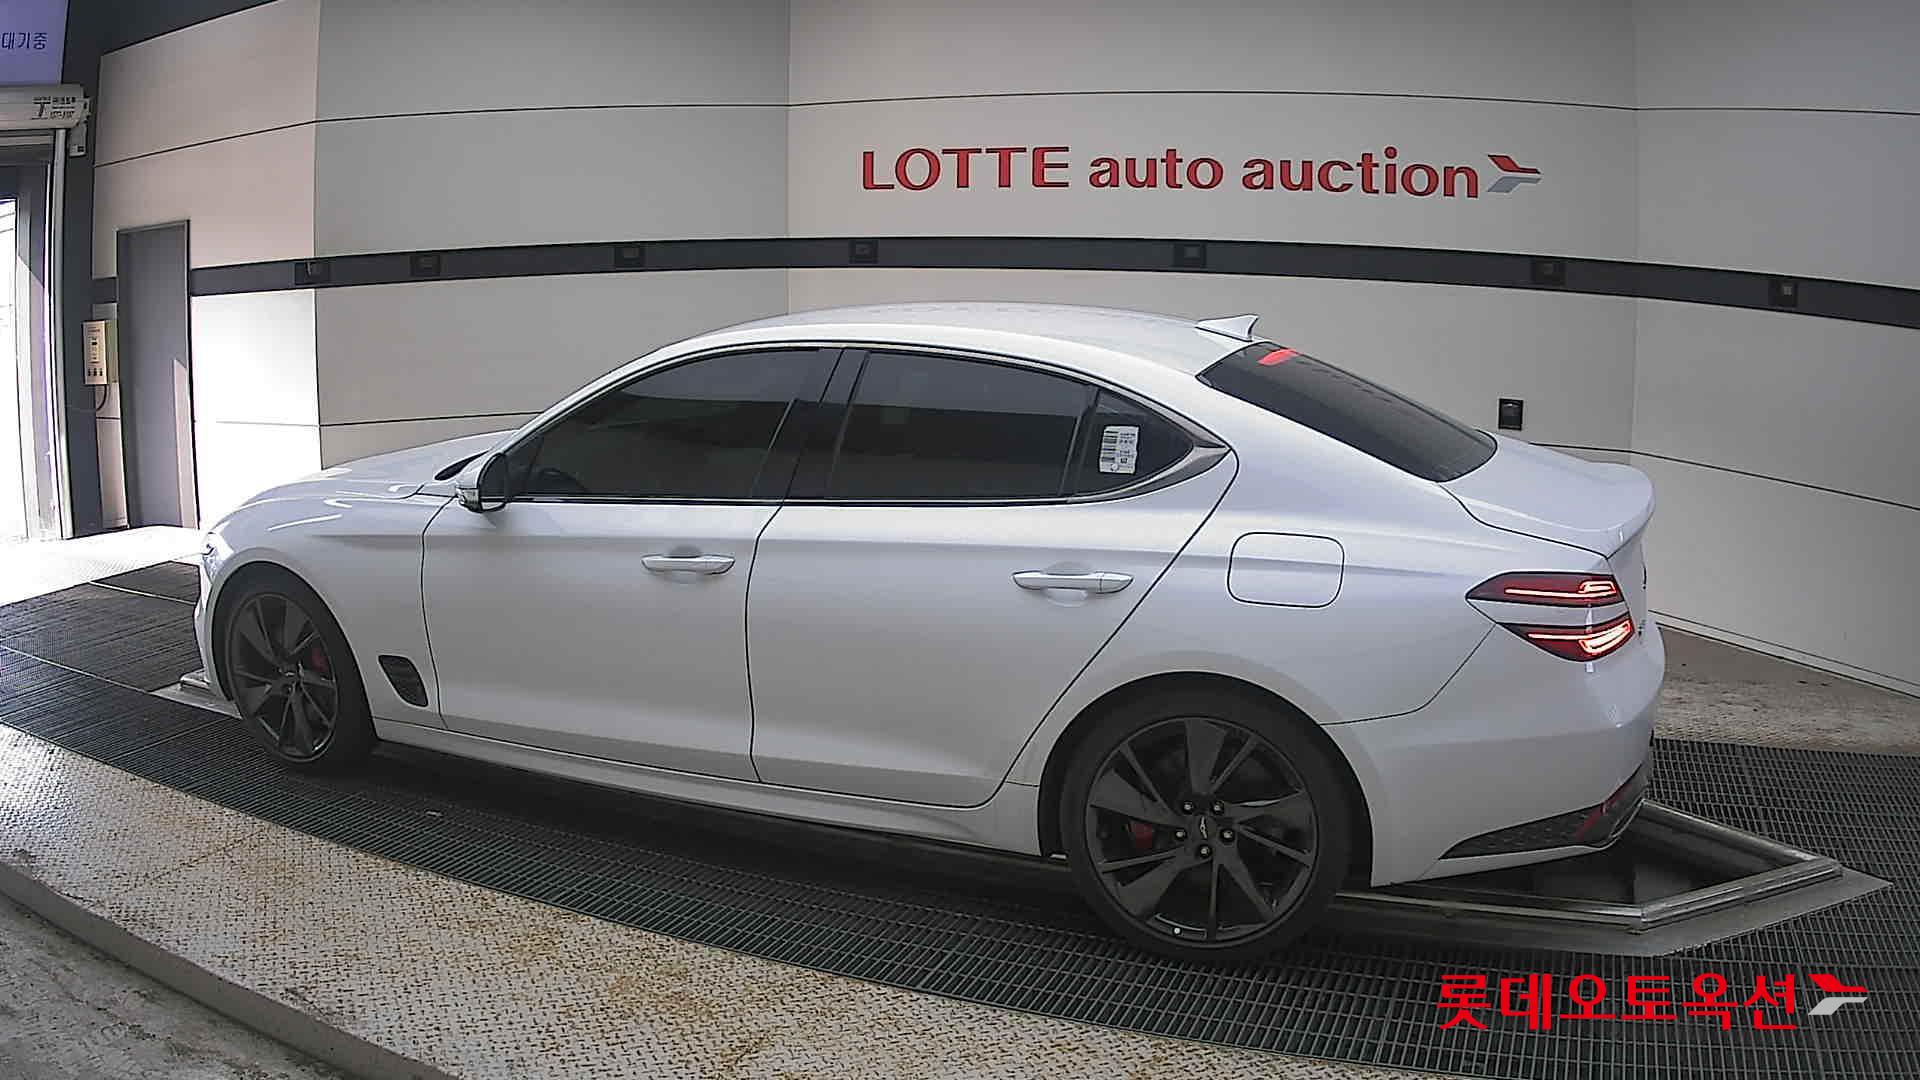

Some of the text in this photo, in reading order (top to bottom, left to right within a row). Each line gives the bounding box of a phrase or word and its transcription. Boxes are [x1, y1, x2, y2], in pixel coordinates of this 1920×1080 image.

[1, 31, 48, 50] 대기중
[862, 146, 1480, 198] LOTTE auto auction
